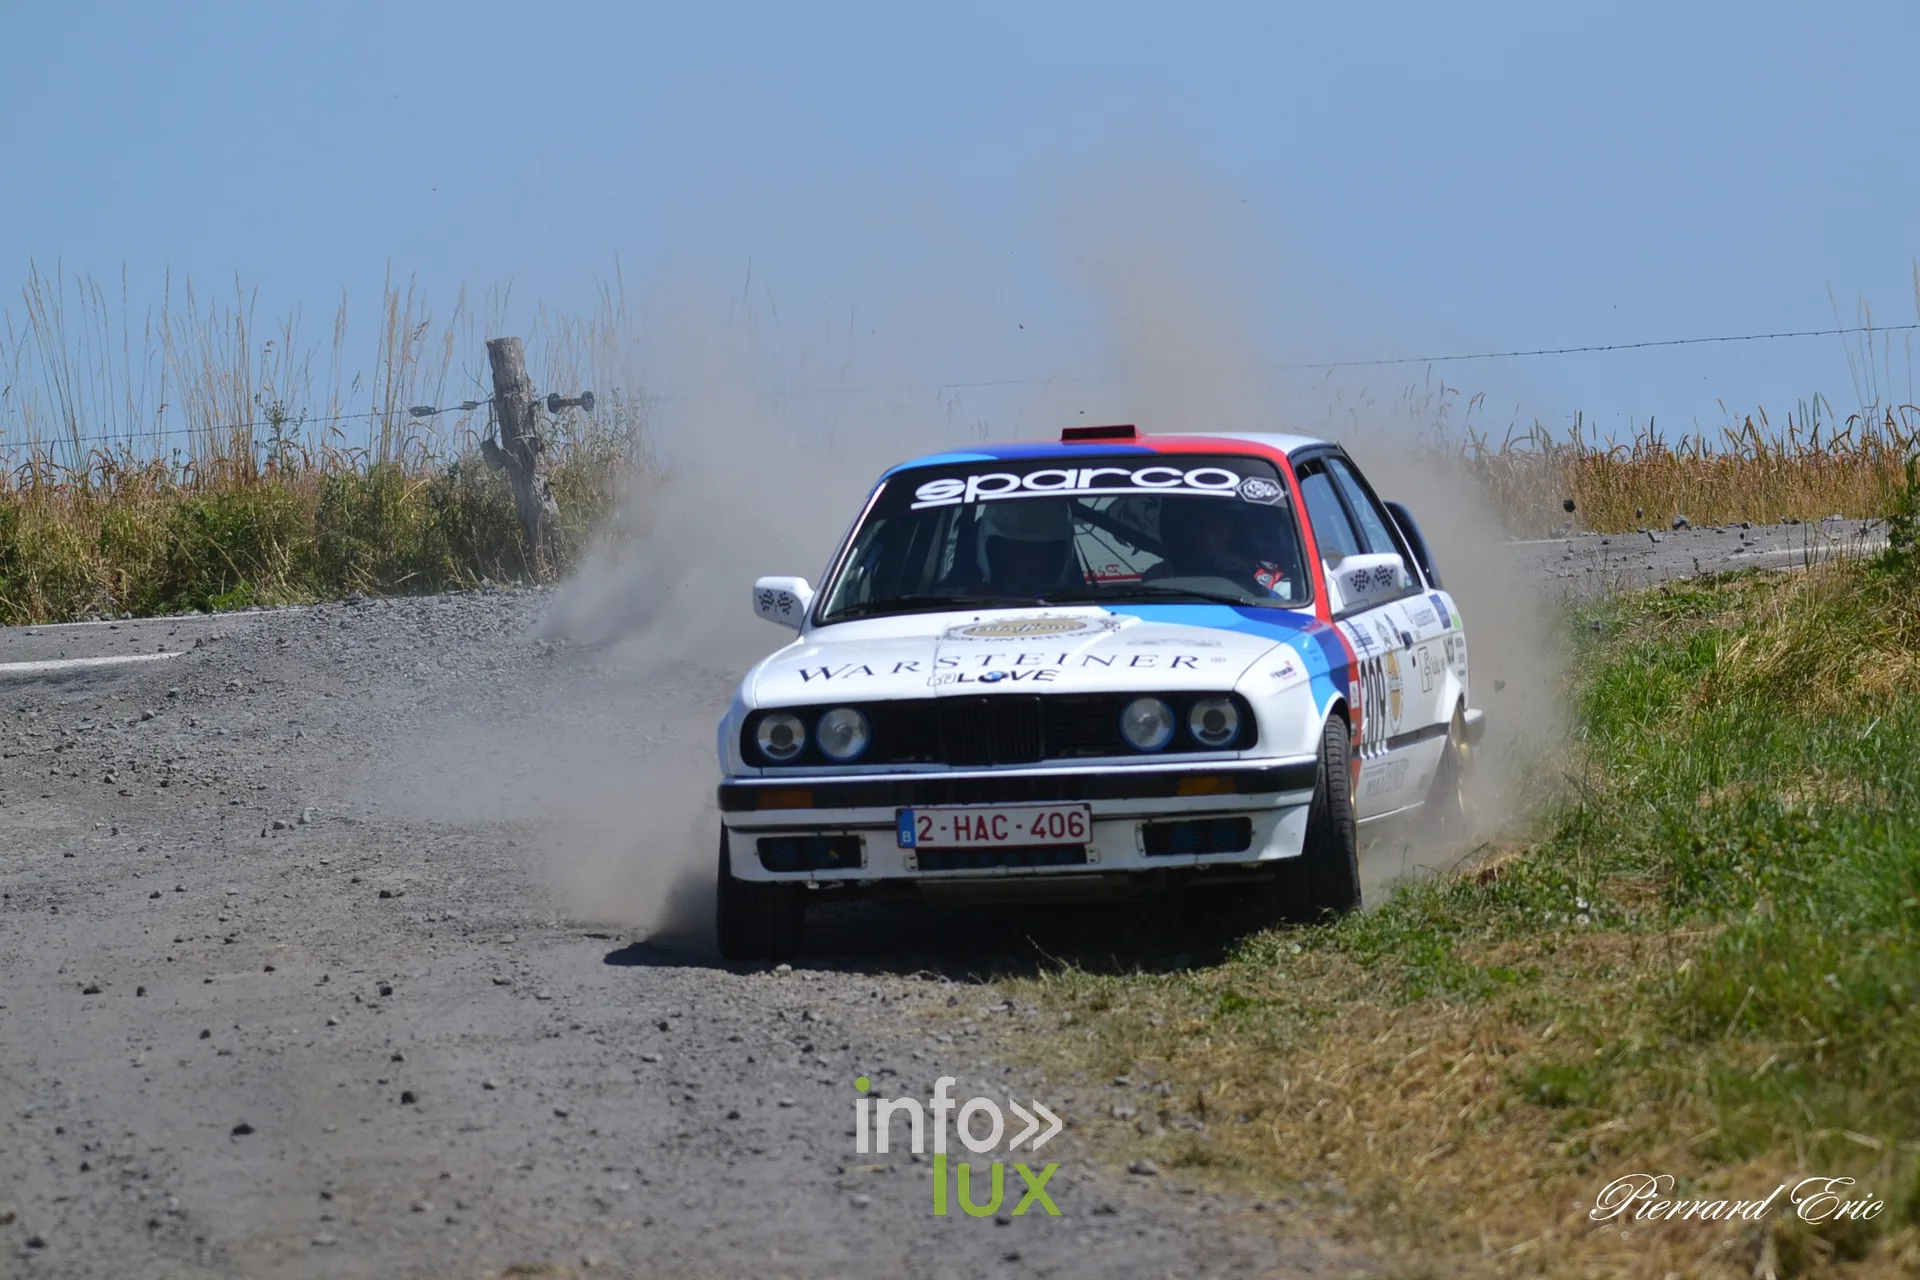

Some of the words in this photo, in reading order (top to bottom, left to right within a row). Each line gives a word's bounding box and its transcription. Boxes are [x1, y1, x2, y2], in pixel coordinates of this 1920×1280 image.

[915, 466, 1241, 504] sparco
[797, 652, 1200, 683] WARSTEINER
[956, 668, 1061, 684] LOVE
[1360, 654, 1388, 760] 309
[901, 830, 913, 844] B
